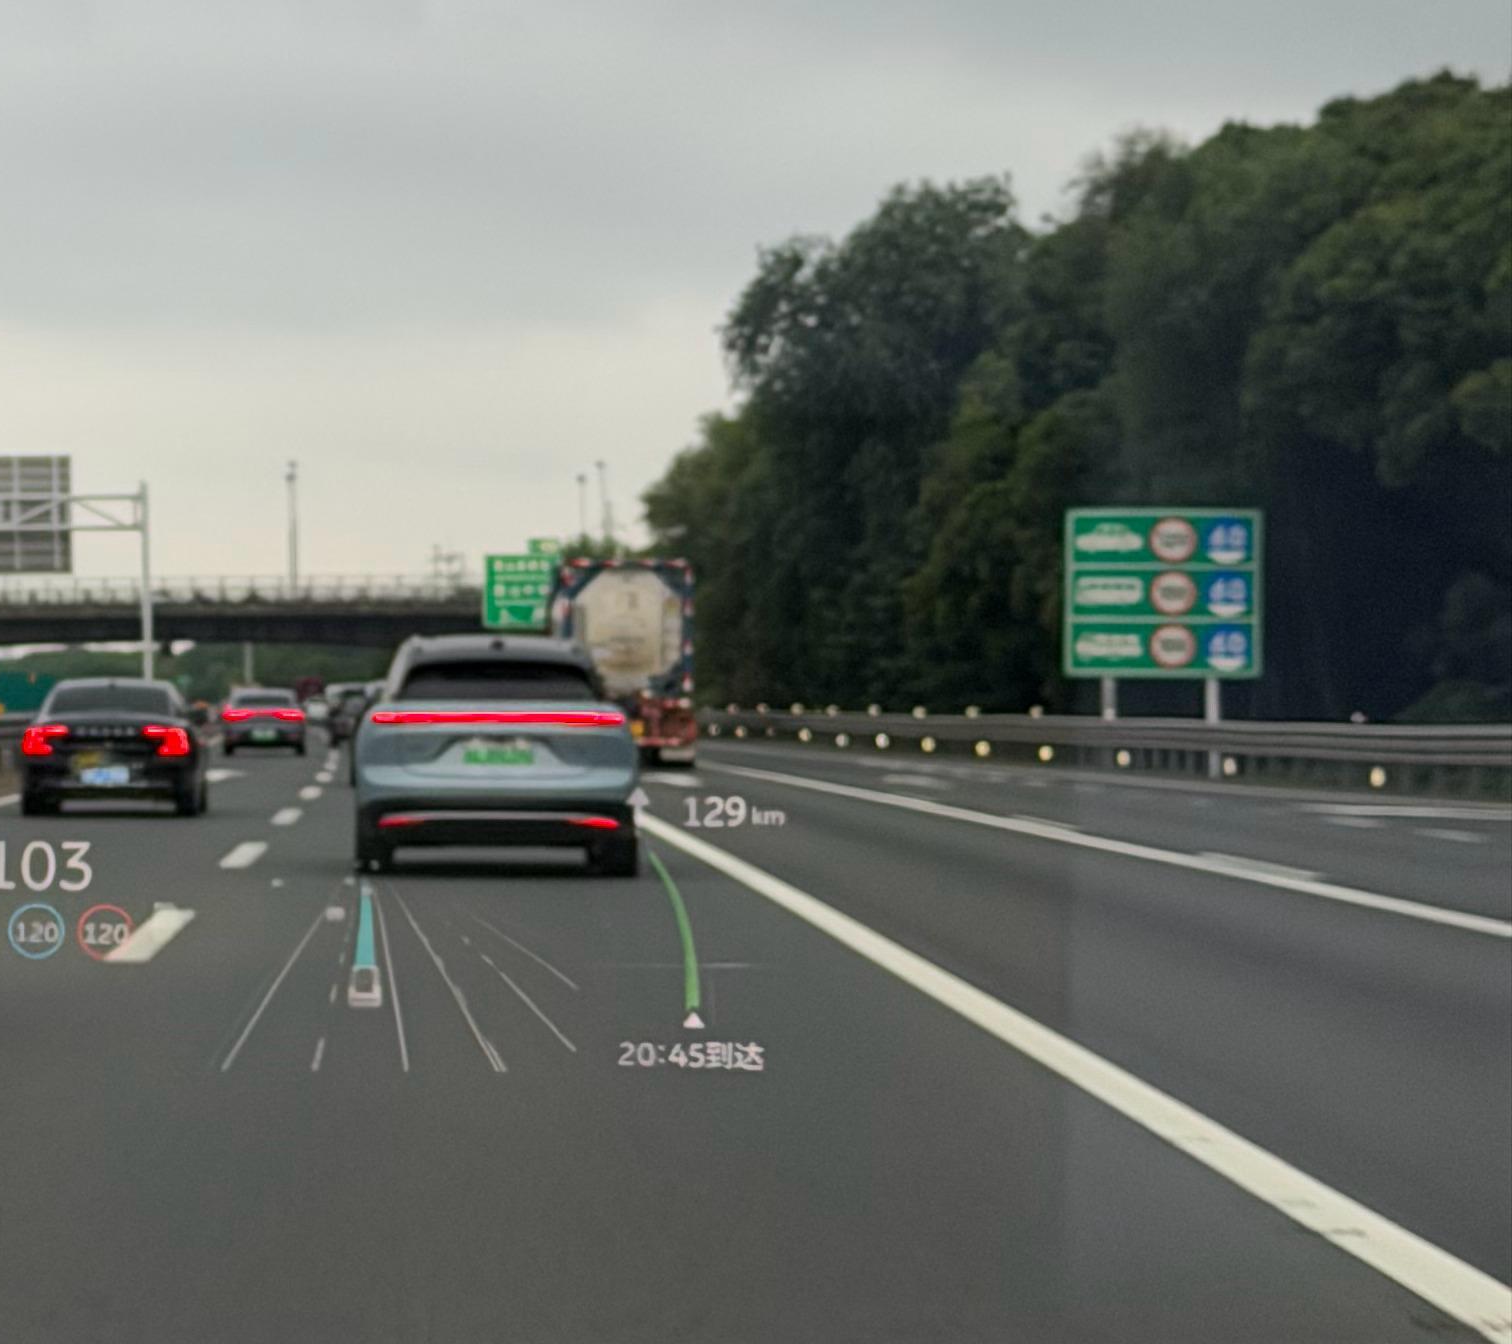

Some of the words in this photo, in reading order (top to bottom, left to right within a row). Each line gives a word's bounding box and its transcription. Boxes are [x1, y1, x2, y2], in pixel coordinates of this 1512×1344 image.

[682, 796, 747, 828] 129
[751, 806, 785, 827] km
[15, 921, 60, 943] 120
[83, 922, 131, 945] 120
[617, 1041, 765, 1071] 20:45到达
